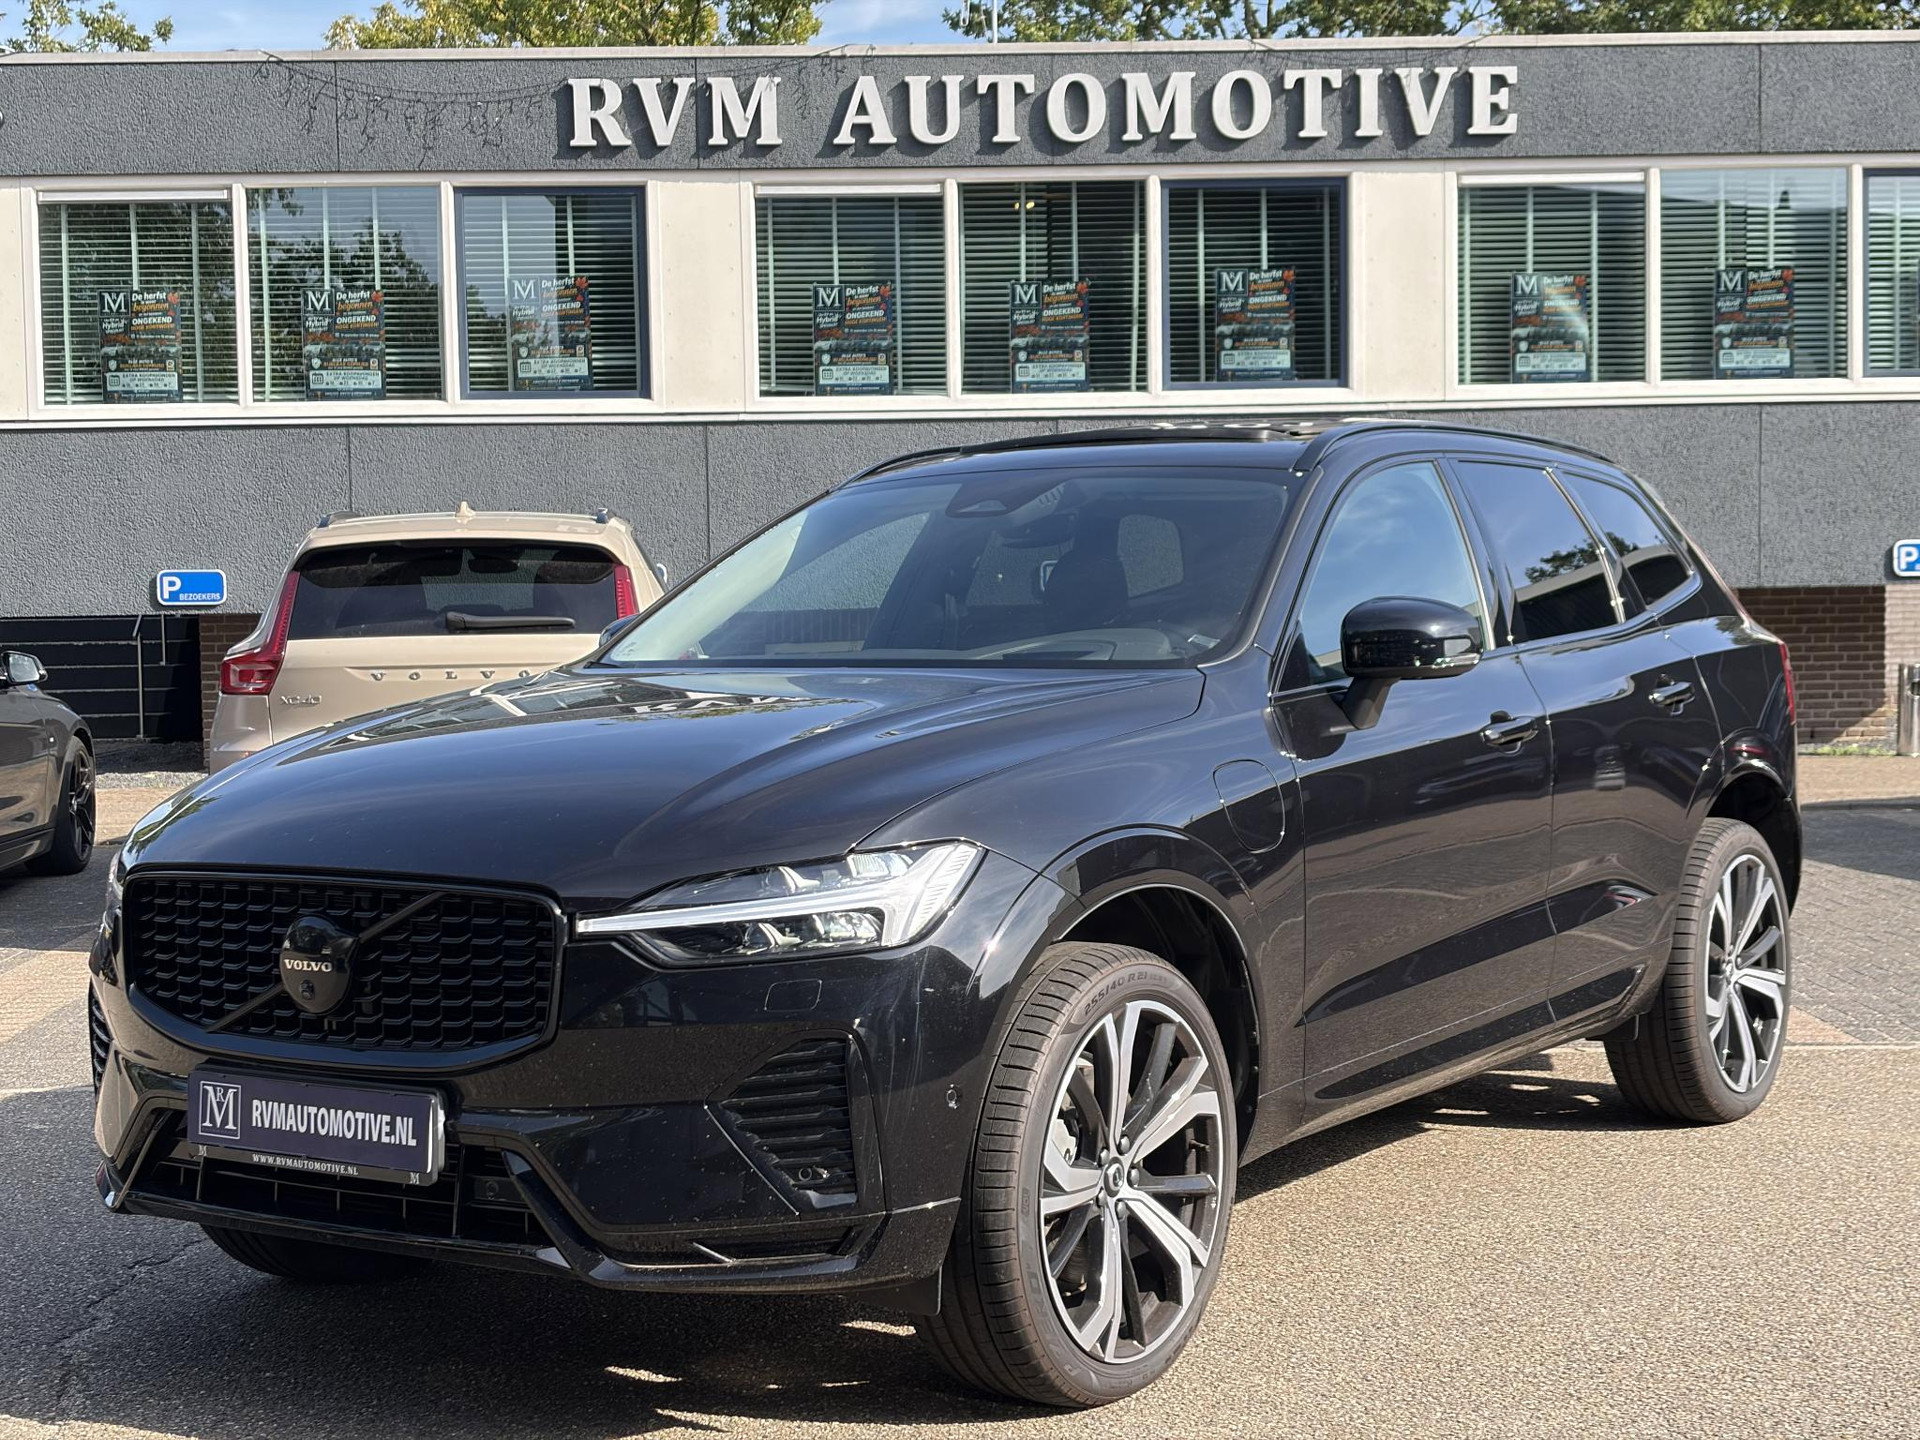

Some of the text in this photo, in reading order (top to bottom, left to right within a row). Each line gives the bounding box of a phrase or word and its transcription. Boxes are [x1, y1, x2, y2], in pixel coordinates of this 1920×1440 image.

[567, 66, 1518, 146] RVM AUTOMOTIVE
[1249, 272, 1261, 281] De
[542, 280, 552, 288] De
[1043, 283, 1076, 293] De herfst
[336, 291, 370, 300] De herfst
[846, 286, 879, 296] De herfst
[132, 292, 166, 301] De herfst
[846, 310, 884, 319] ONGEKEND
[1043, 307, 1081, 316] ONGEKEND
[132, 317, 172, 325] ONGEKEND
[337, 315, 376, 323] ONGEKEND
[817, 315, 838, 323] Hybrid
[162, 576, 181, 599] P
[179, 592, 221, 601] BEZOEKERS
[371, 669, 531, 682] VOLVO
[284, 959, 332, 972] VOLVO
[1085, 976, 1125, 1016] 255/40
[251, 1099, 417, 1147] RVMAUTOMOTIVE.NL
[252, 1153, 359, 1176] WWW.RVMAUTOMOTIVE.NL
